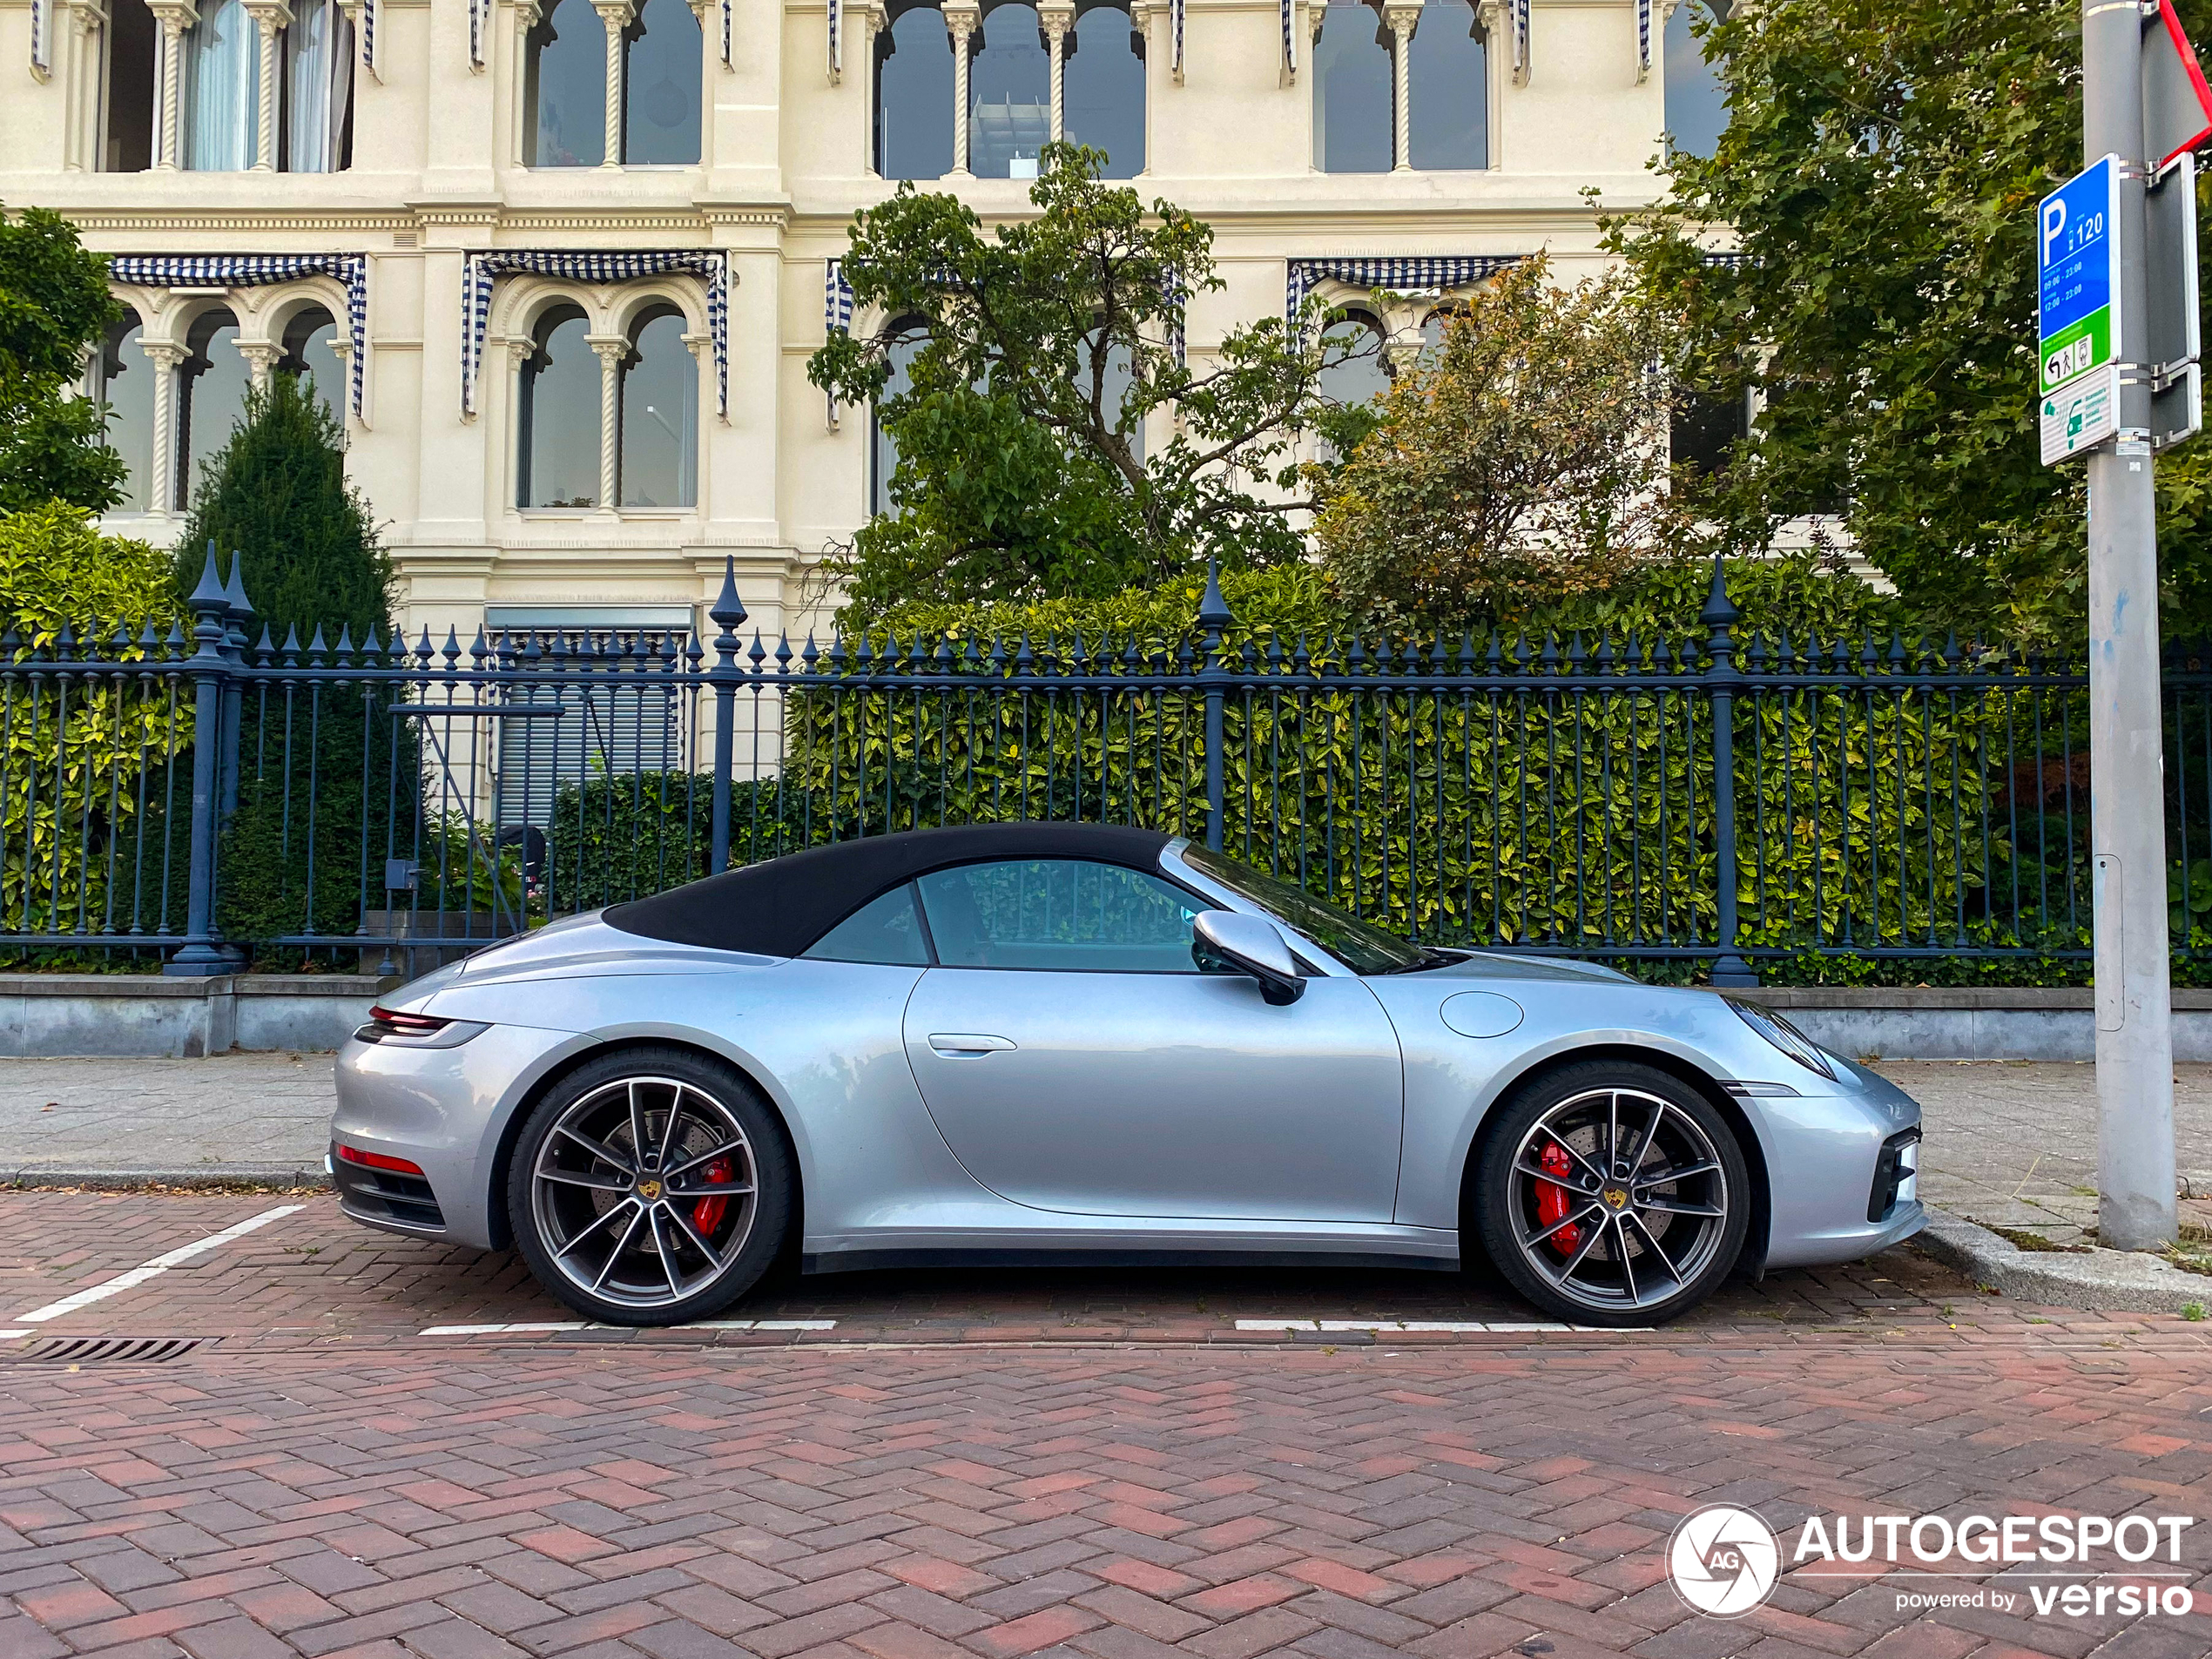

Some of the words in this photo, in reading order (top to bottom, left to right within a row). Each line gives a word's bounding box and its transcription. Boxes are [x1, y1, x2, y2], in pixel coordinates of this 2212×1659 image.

[2043, 198, 2067, 267] P
[2076, 212, 2103, 245] 120
[2065, 283, 2082, 301] 23:00
